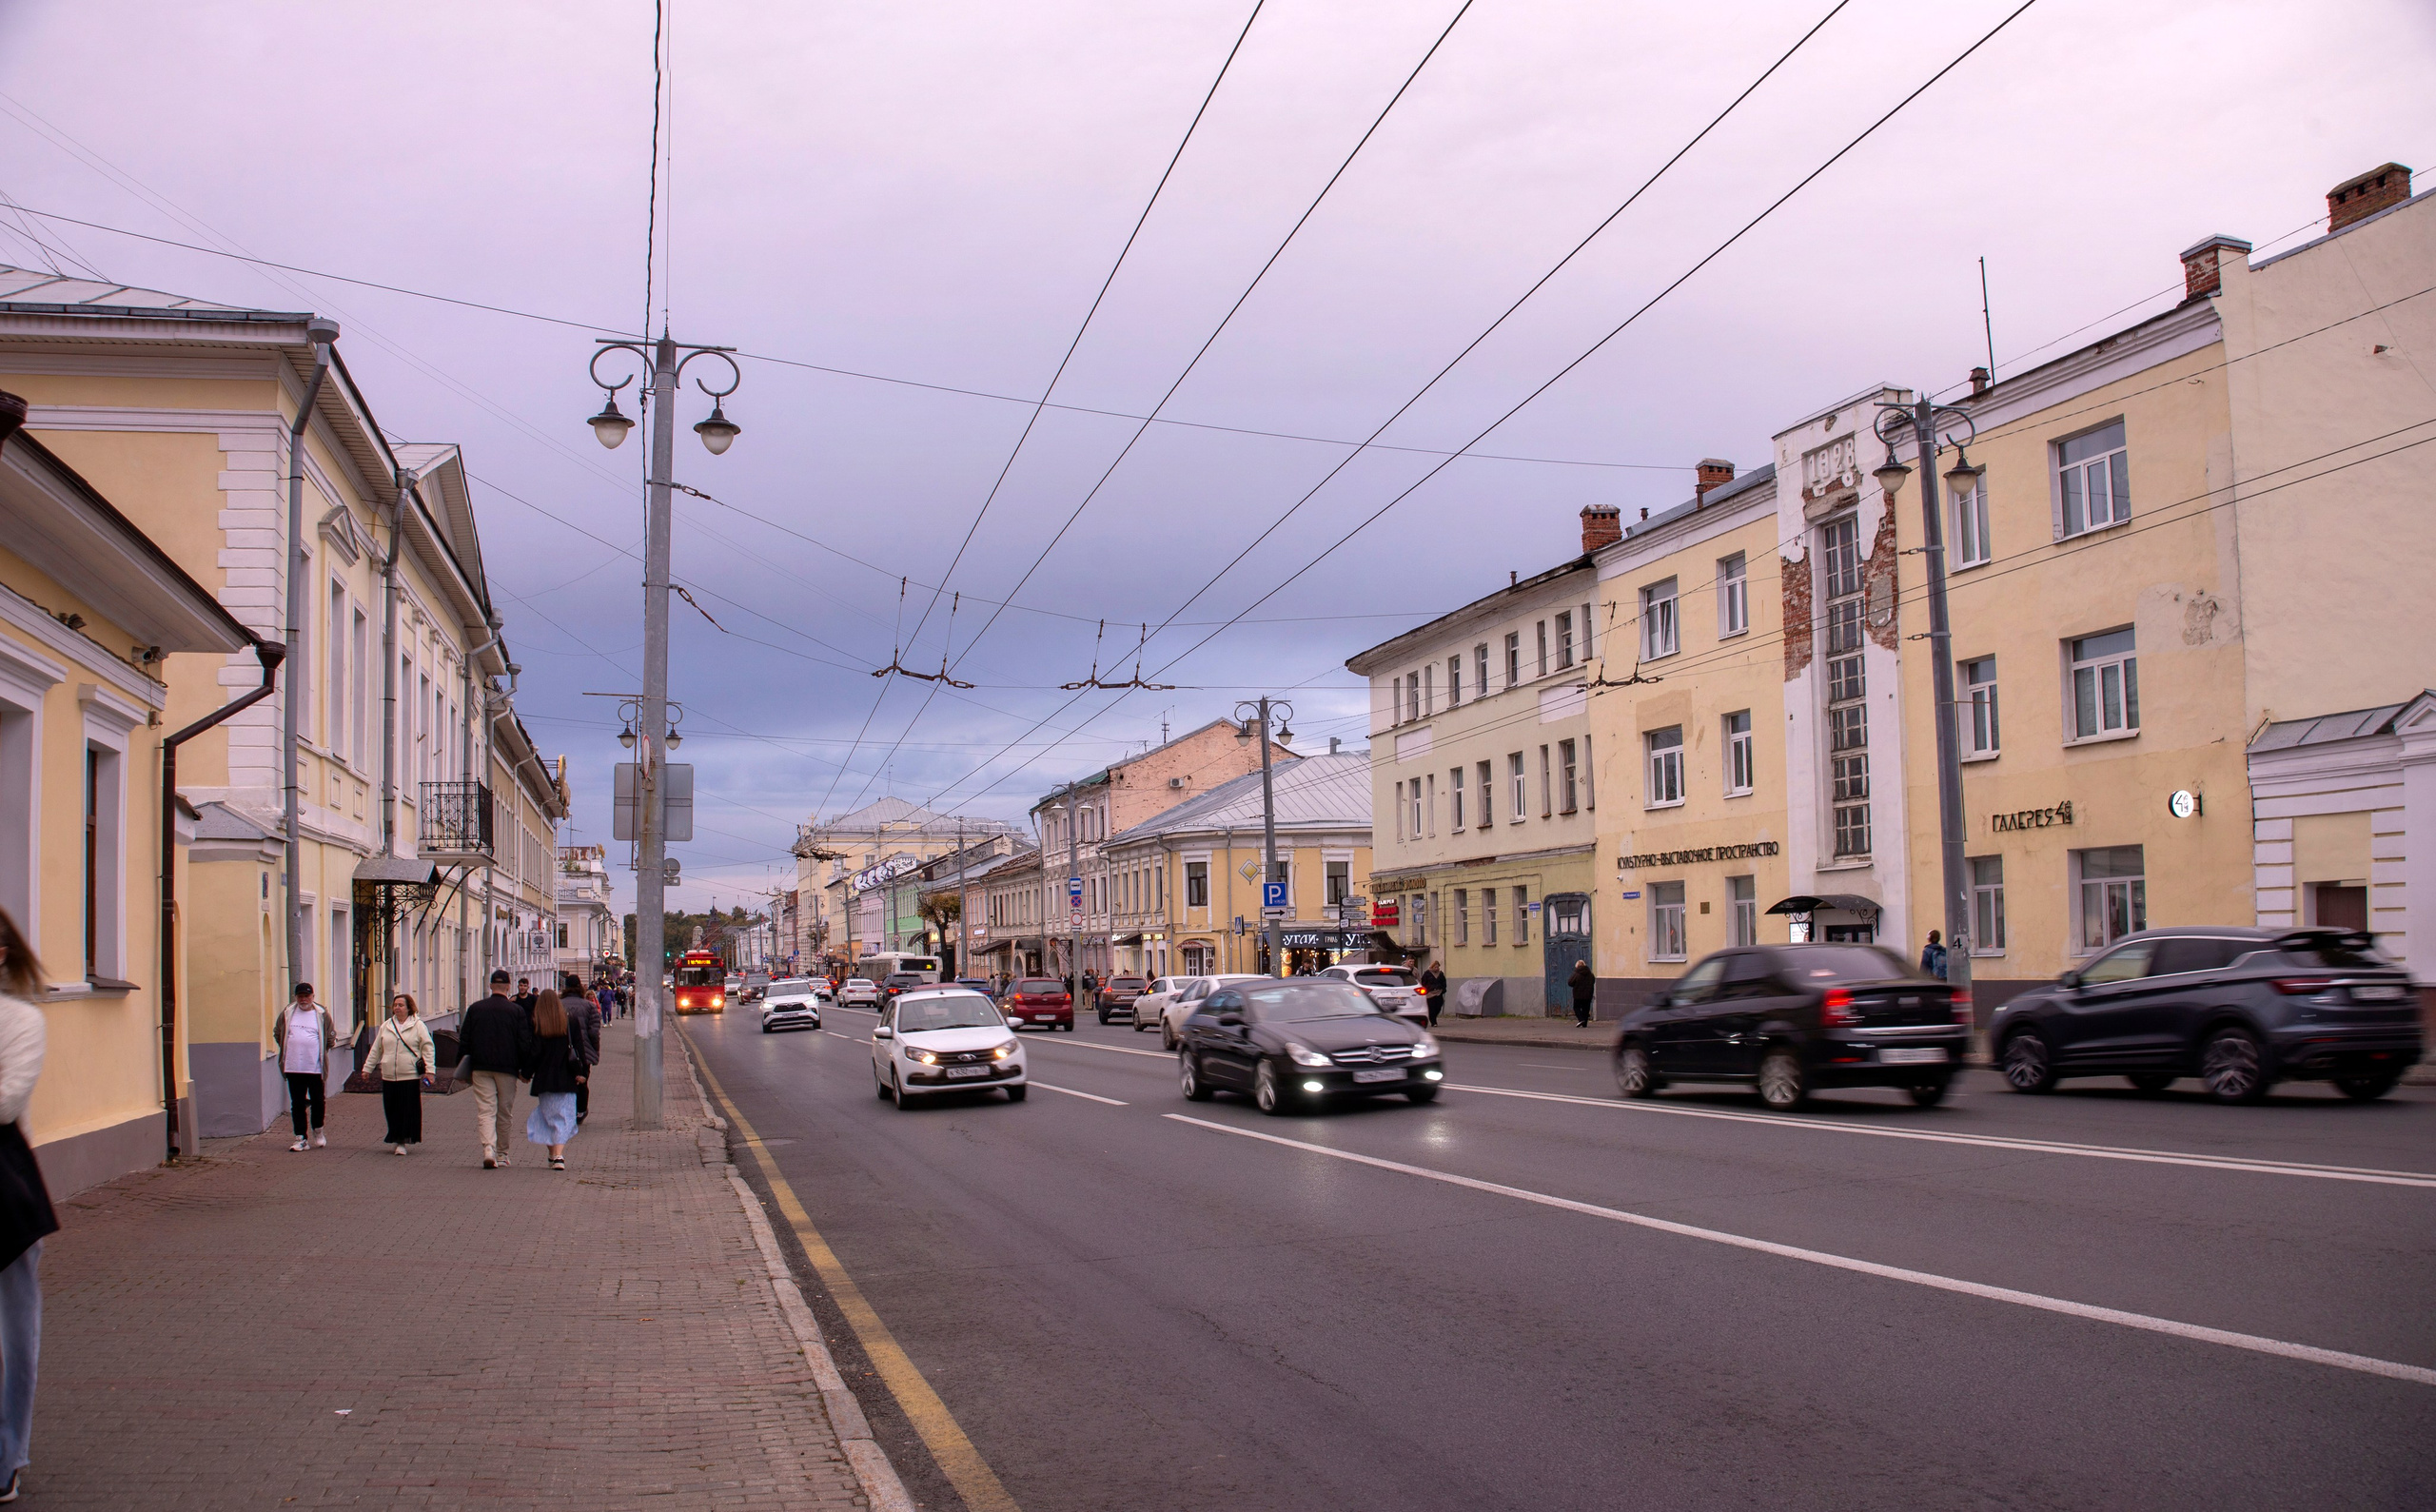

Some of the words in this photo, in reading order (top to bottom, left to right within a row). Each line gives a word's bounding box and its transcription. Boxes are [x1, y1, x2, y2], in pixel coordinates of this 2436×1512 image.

[1992, 807, 2053, 832] ГАЛЕРЕЯ
[1716, 841, 1778, 859] ПРОСТРАНСТВО
[1268, 885, 1282, 904] P
[1284, 933, 1317, 946] УГЛИ
[1953, 937, 1962, 949] 4
